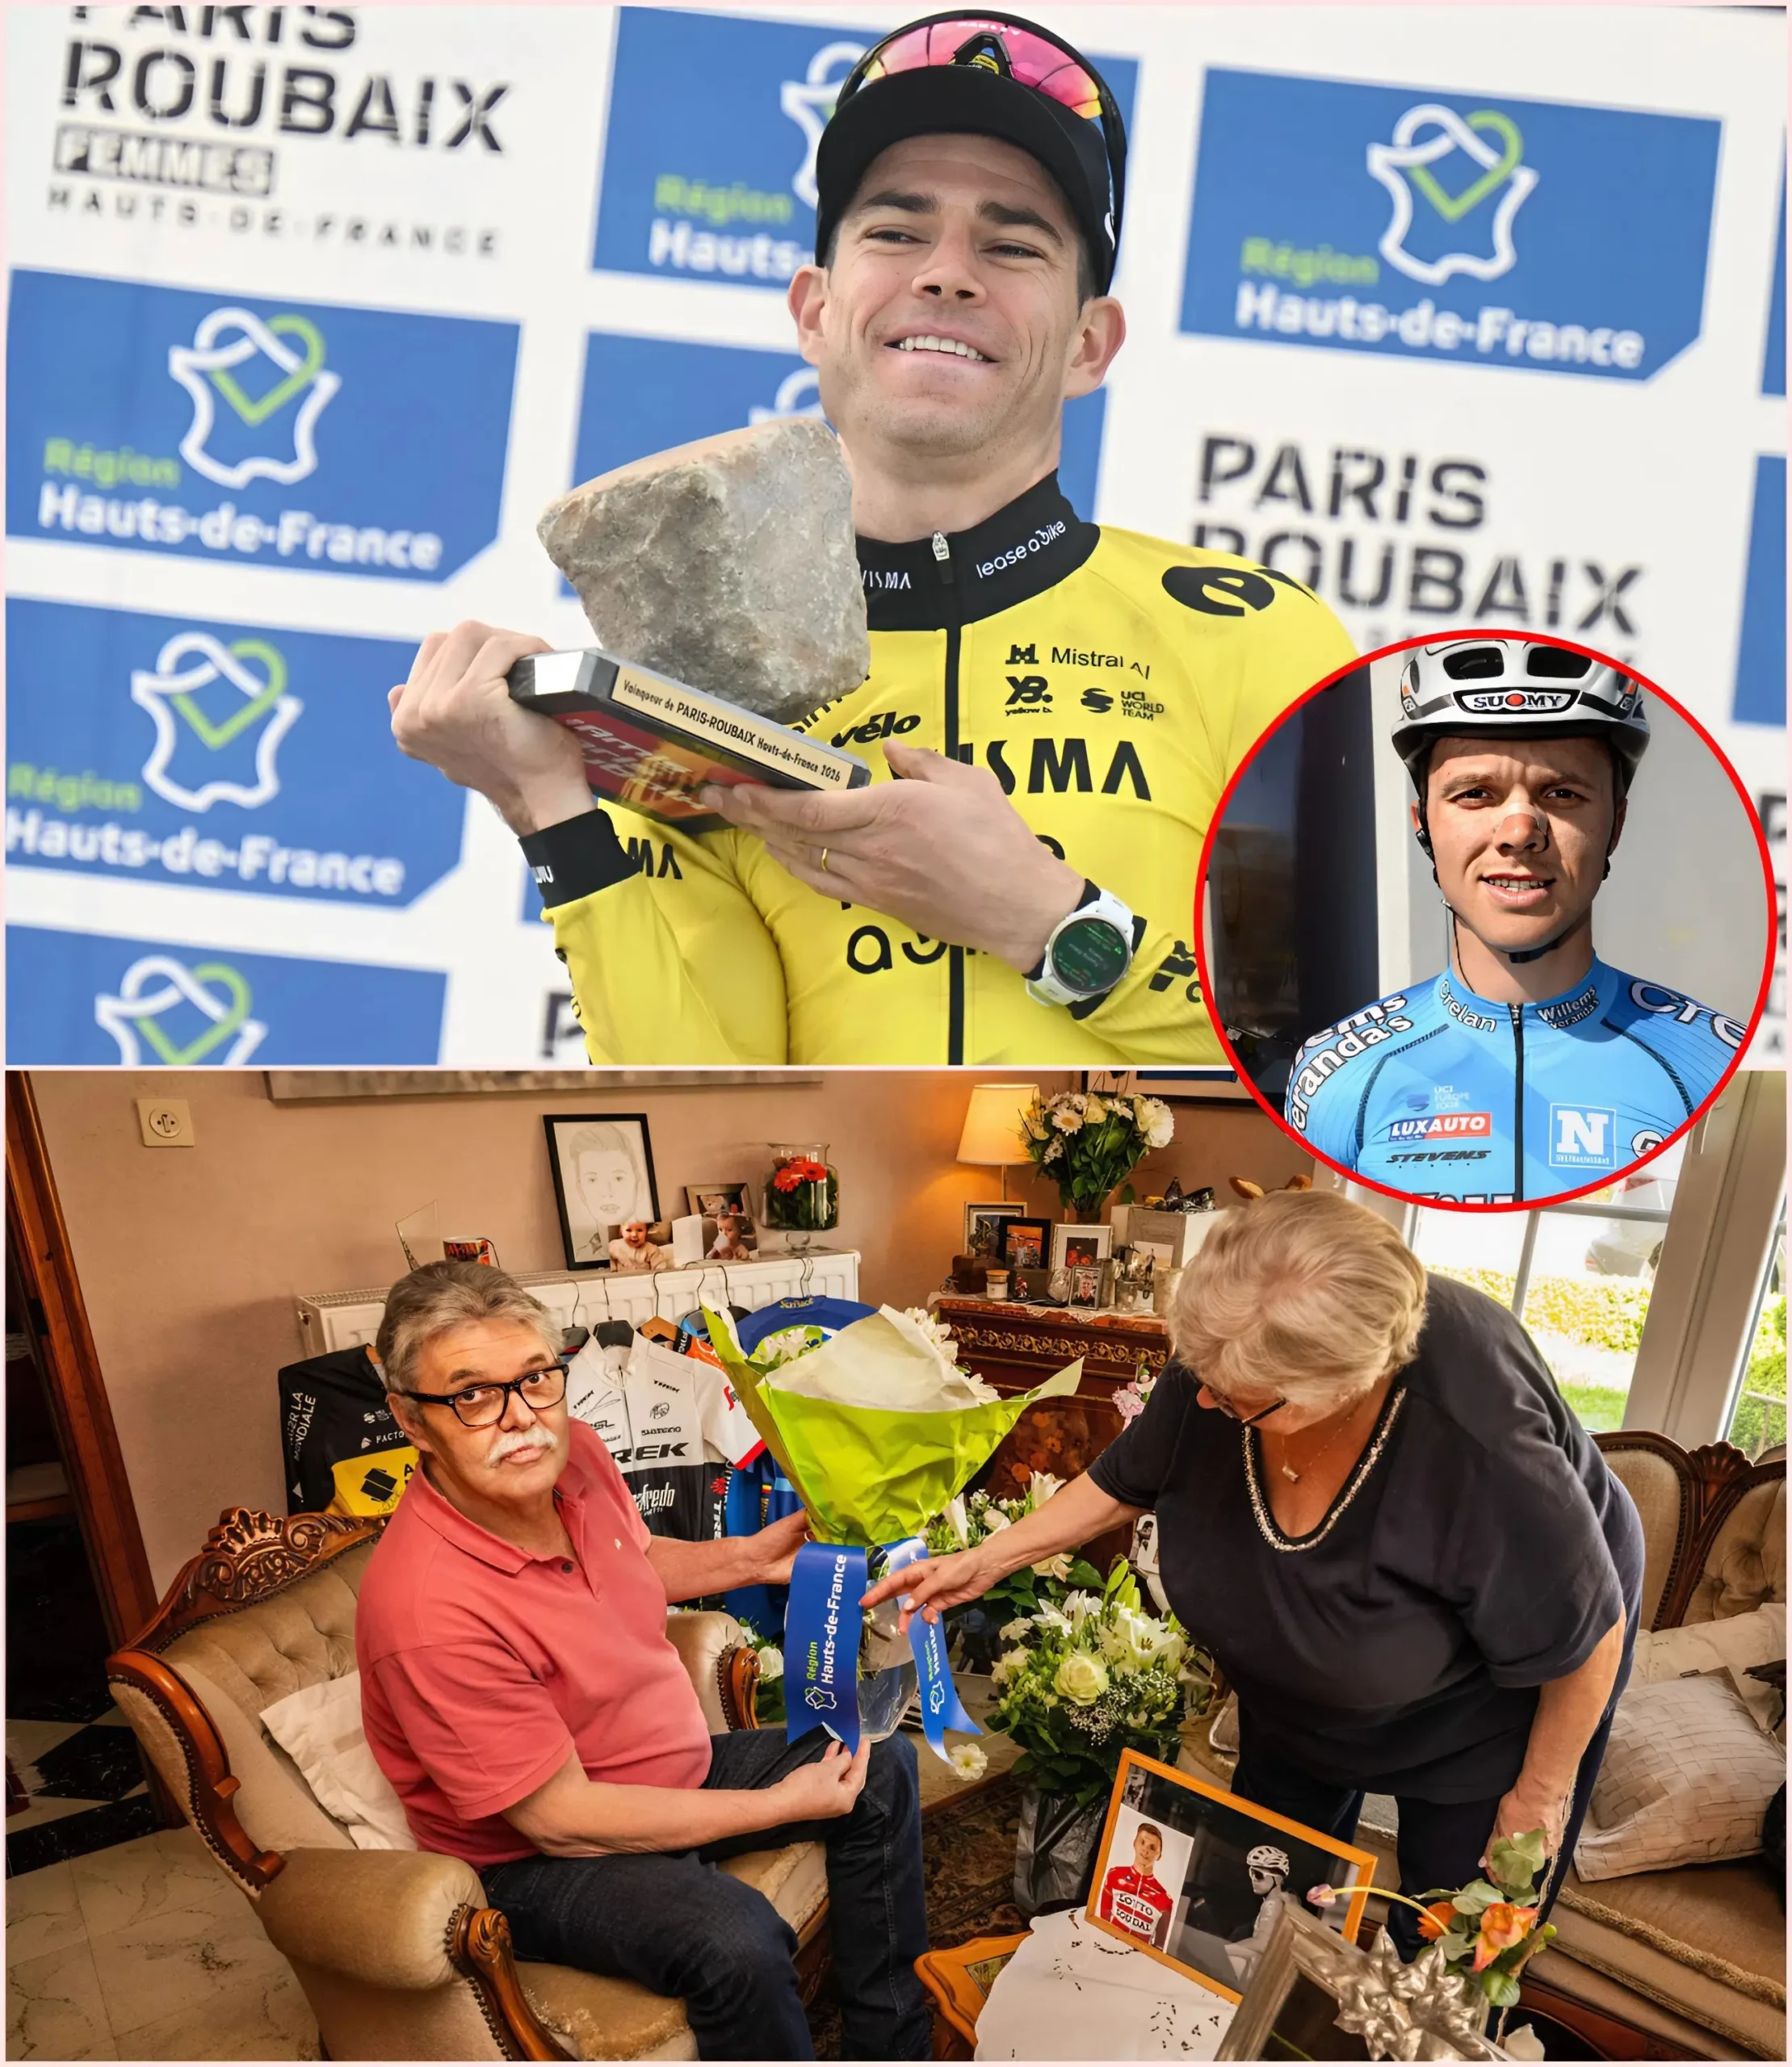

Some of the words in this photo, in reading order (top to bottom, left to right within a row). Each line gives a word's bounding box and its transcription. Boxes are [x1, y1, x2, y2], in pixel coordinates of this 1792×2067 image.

[63, 41, 509, 152] ROUBAIX
[655, 174, 792, 224] Région
[1240, 237, 1379, 287] Région
[1236, 281, 1645, 370] Hauts-de-France
[44, 438, 180, 488] Région
[1198, 435, 1491, 530] PARIS
[39, 482, 443, 570] Hauts-de-France
[976, 545, 1027, 578] lease
[1051, 647, 1123, 668] Mistral
[1131, 662, 1150, 680] AI
[1121, 690, 1145, 701] UCI
[1121, 700, 1165, 714] WORLD
[1122, 707, 1154, 721] TEAM
[1473, 693, 1562, 709] SUOMY
[677, 702, 756, 746] PARIS-ROUBAIX
[757, 737, 818, 773] Hauts-de-France
[820, 765, 841, 782] 2026
[830, 711, 921, 748] vélo
[7, 762, 141, 812] Région
[1439, 979, 1496, 1033] Crelan
[1537, 987, 1596, 1022] Willems
[1291, 1015, 1414, 1131] eranda's
[1391, 1117, 1486, 1137] LUXAUTO
[1556, 1110, 1609, 1155] N
[1386, 1151, 1492, 1163] STEVENS
[292, 1392, 304, 1411] LA
[376, 1430, 405, 1444] FACTO
[611, 1442, 689, 1464] REK
[821, 1553, 847, 1684] Hauts-de-France
[806, 1641, 819, 1680] Région
